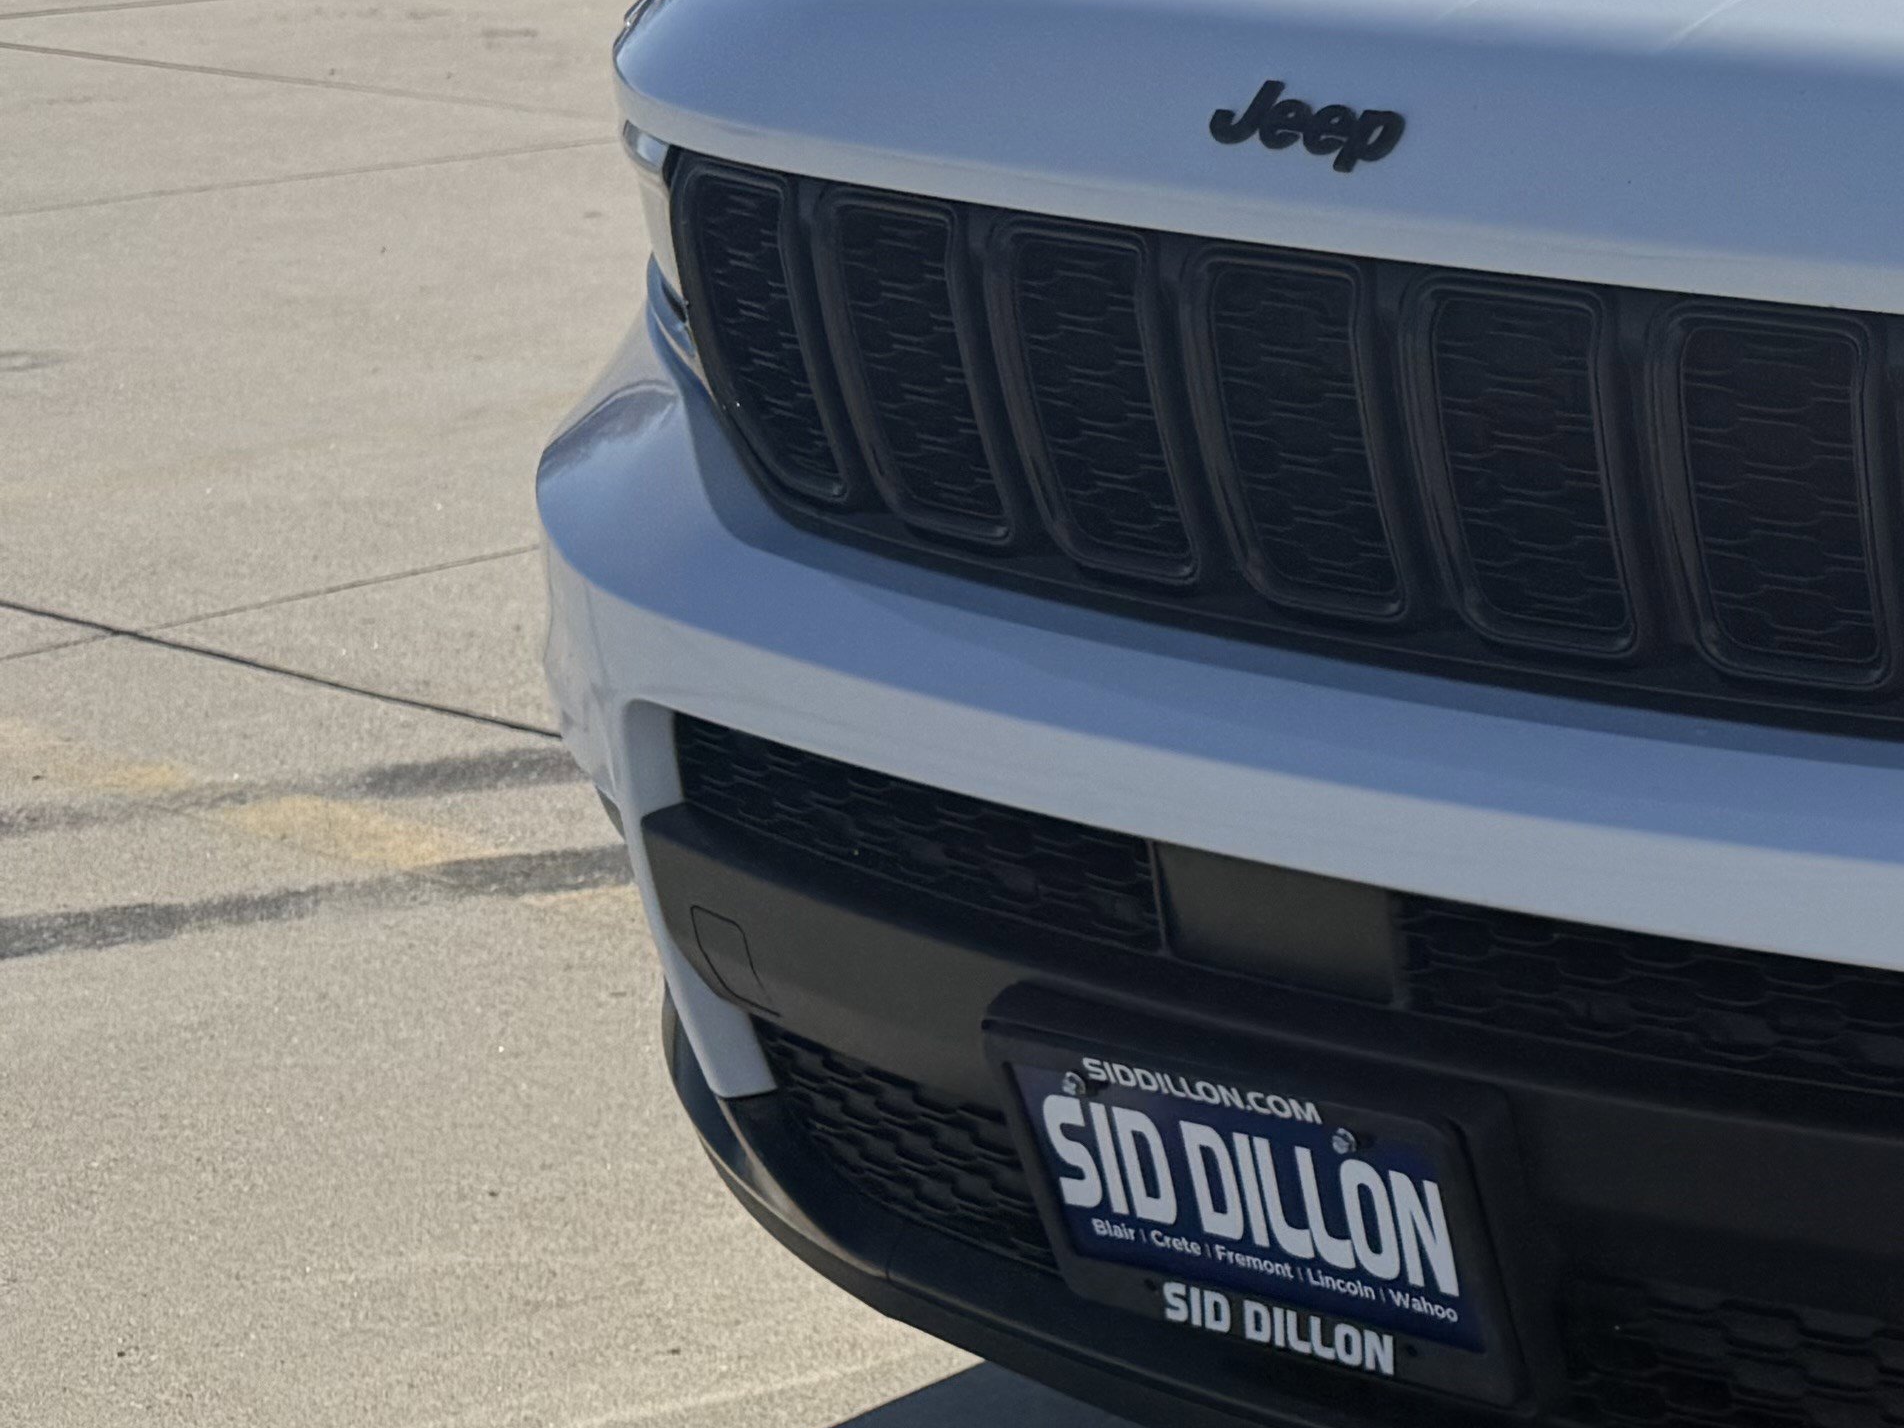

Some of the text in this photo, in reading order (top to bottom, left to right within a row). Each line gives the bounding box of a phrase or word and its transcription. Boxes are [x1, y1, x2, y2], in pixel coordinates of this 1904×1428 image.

[1209, 79, 1407, 174] Jeep
[1082, 1056, 1323, 1125] SIDDILLON.COM
[1042, 1093, 1460, 1298] SID DILLON
[1091, 1217, 1459, 1323] Blair Crete Fremont Lincoln Wahoo
[1162, 1281, 1396, 1377] SID DILLON
